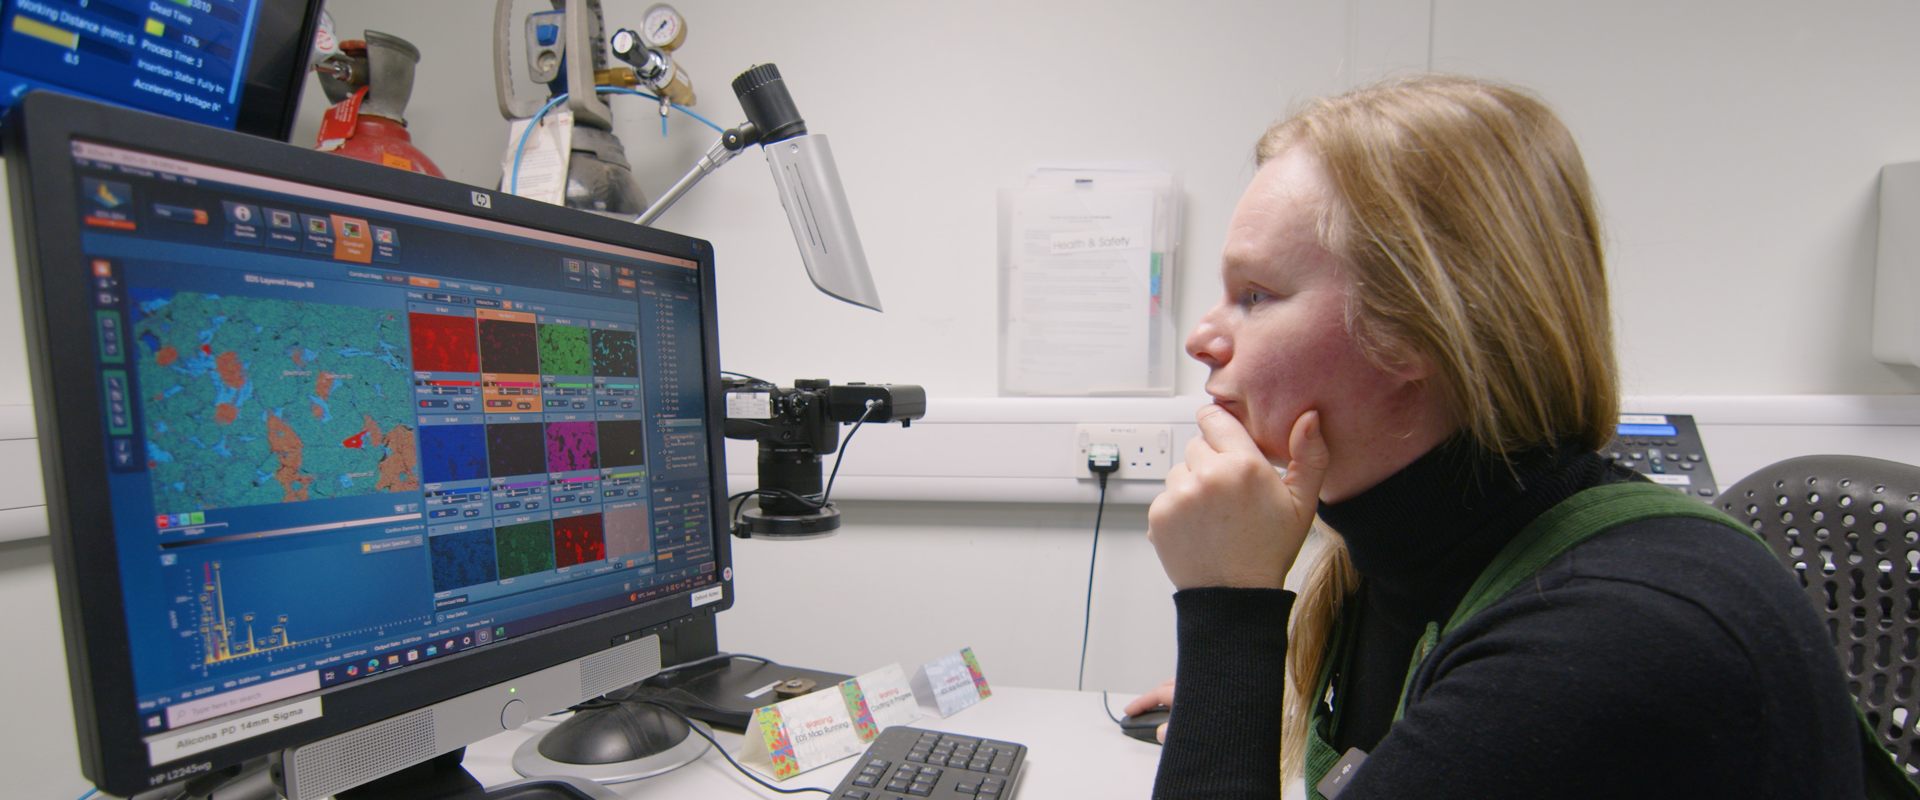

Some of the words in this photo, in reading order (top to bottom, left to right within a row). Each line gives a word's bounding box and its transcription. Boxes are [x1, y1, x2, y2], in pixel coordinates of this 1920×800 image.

[149, 1, 173, 17] Dead
[173, 9, 193, 25] Time
[60, 10, 100, 33] Distance
[182, 34, 200, 48] 17%
[63, 51, 80, 65] 8.5
[141, 39, 173, 58] Process
[174, 50, 196, 67] Time:
[197, 58, 203, 68] 3
[138, 59, 174, 77] Insertion
[174, 70, 196, 86] State:
[197, 78, 216, 92] Fully
[133, 79, 182, 102] Accelerating
[183, 93, 212, 109] Voltage
[342, 240, 365, 248] Construct
[1053, 239, 1086, 251] Health
[1087, 238, 1096, 248] &
[1098, 236, 1131, 248] Safety
[347, 247, 361, 255] Maps
[245, 274, 259, 282] EDS
[259, 276, 286, 286] Layered
[285, 279, 306, 288] Image
[349, 270, 370, 278] Construct
[407, 291, 423, 299] Display
[436, 599, 456, 608] Minimized
[694, 593, 709, 602] Oxford
[466, 621, 479, 629] Process
[374, 643, 391, 651] Output
[390, 640, 402, 648] Rate:
[315, 658, 328, 666] Input
[270, 666, 296, 677] AutoLock:
[878, 687, 900, 699] Warning
[192, 706, 211, 716] Type
[212, 700, 229, 709] here
[229, 698, 238, 706] to
[238, 692, 262, 704] search
[870, 700, 891, 712] Coating
[894, 691, 913, 702] Progress
[175, 732, 218, 750] Alicona
[220, 725, 237, 737] PD
[240, 716, 270, 731] 14mm
[273, 708, 304, 723] Sigma
[804, 715, 834, 729] Warning
[795, 733, 808, 744] EDS
[808, 729, 824, 739] Map
[823, 721, 850, 733] Running
[150, 775, 166, 786] HP
[166, 761, 213, 782] L2245wg
